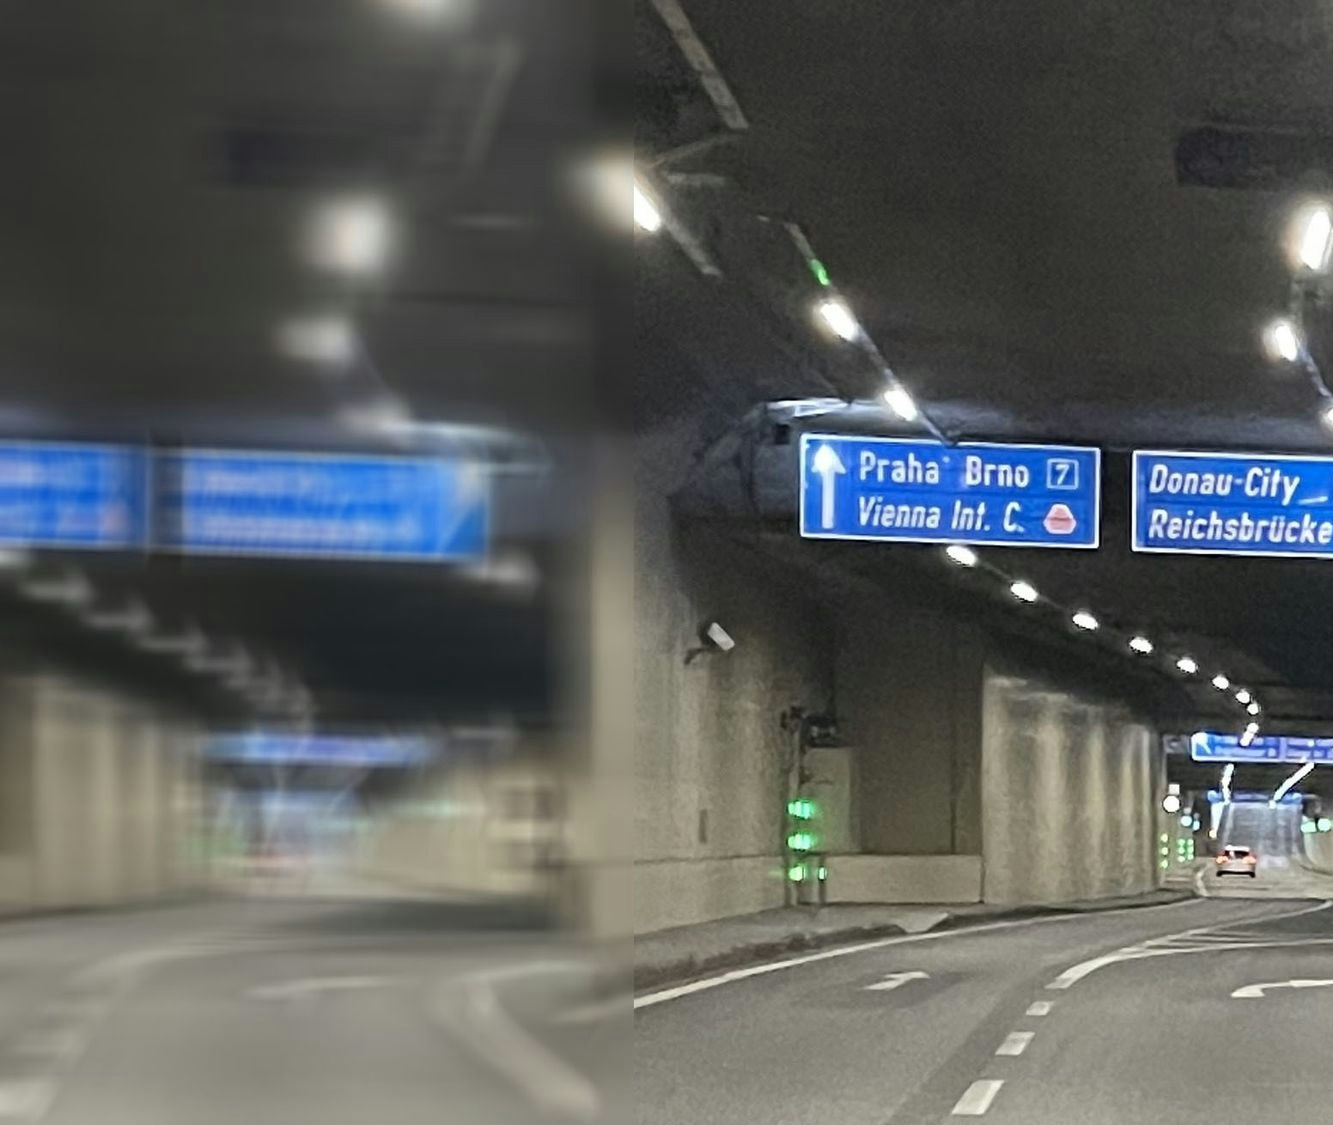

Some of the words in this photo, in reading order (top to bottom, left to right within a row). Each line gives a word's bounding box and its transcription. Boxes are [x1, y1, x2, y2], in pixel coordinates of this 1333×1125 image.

[859, 450, 940, 484] Praha
[965, 455, 1030, 488] Brno
[1055, 463, 1070, 486] 7
[1149, 463, 1300, 506] Donau-City
[859, 496, 941, 529] Vienna
[951, 499, 991, 531] Int.
[1149, 508, 1333, 544] Reichsbrücke
